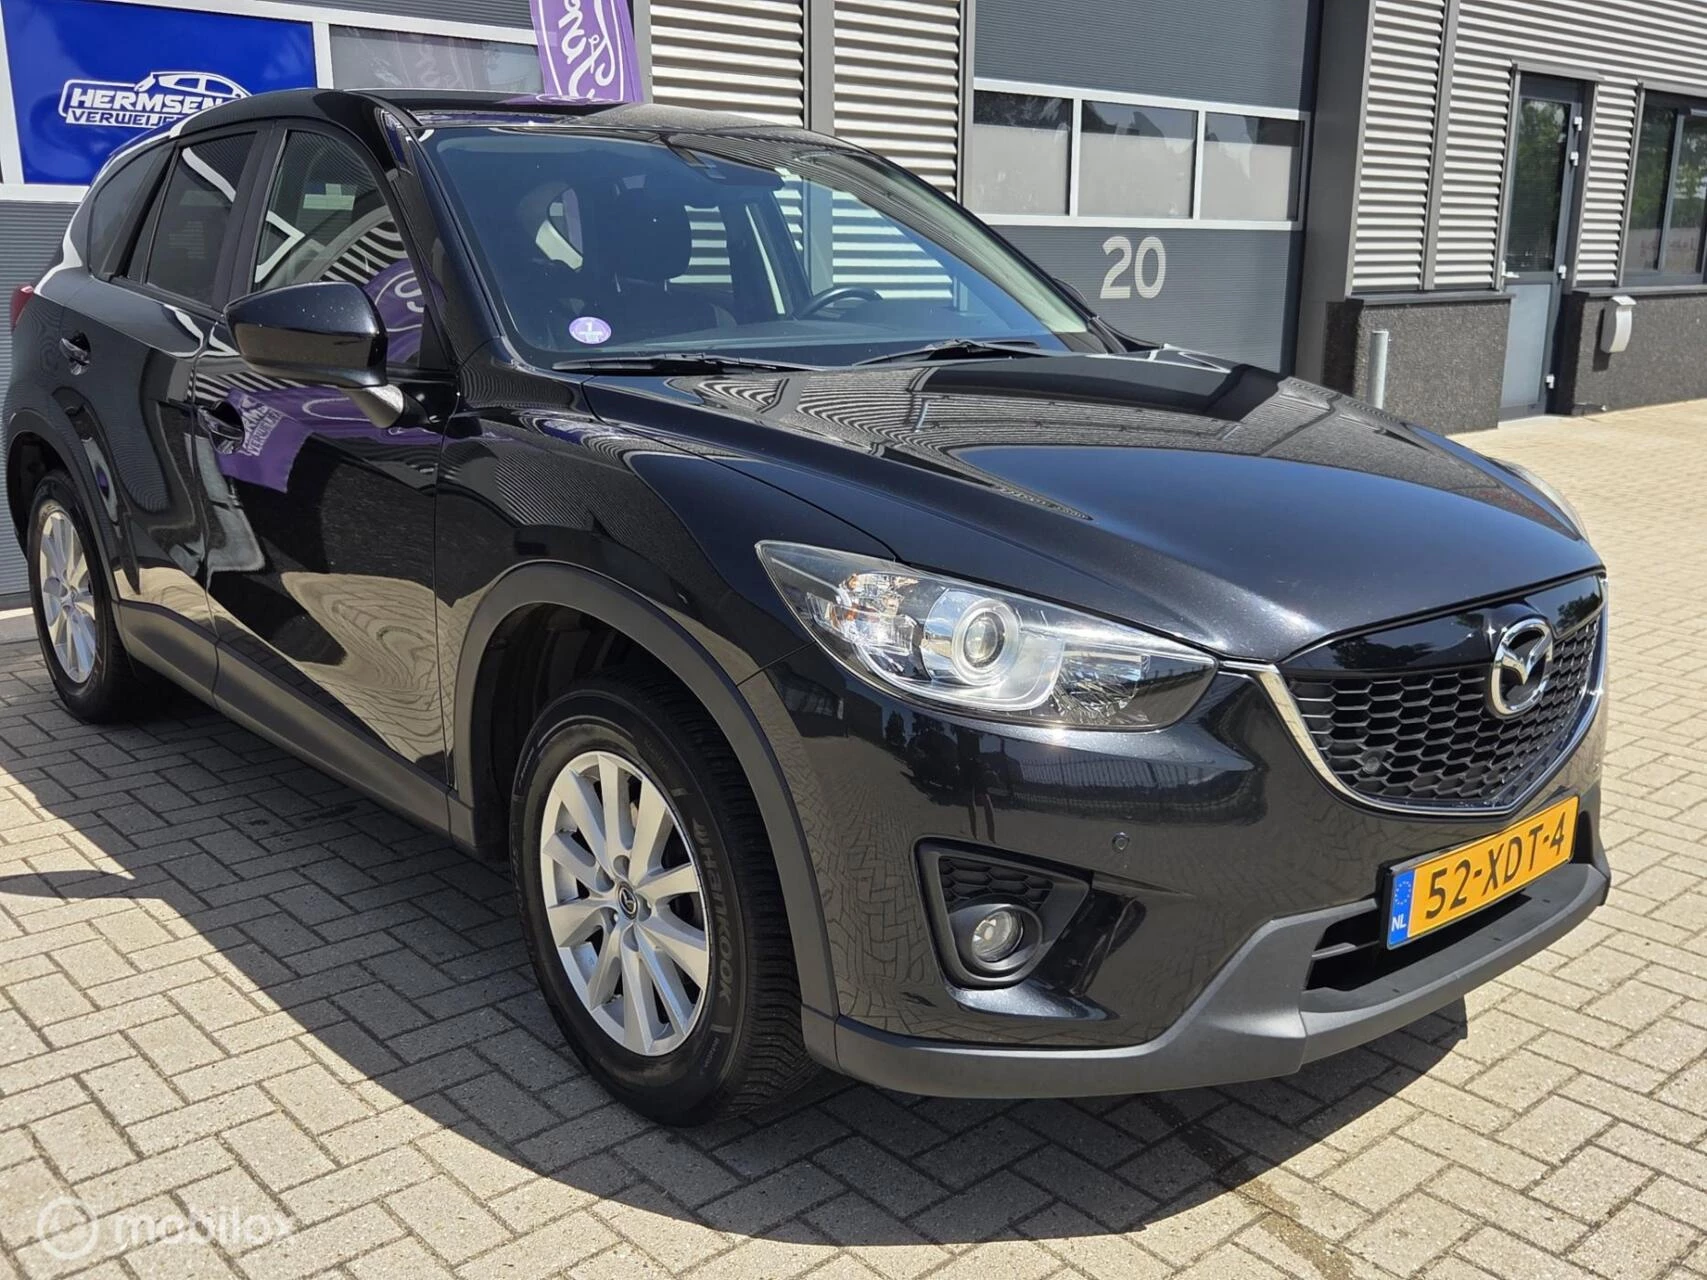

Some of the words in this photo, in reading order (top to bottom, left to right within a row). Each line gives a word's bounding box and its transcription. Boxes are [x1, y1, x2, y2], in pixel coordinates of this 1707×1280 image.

[1101, 236, 1166, 299] 20
[1425, 812, 1566, 920] 52-XDT-4
[1391, 915, 1407, 931] NL
